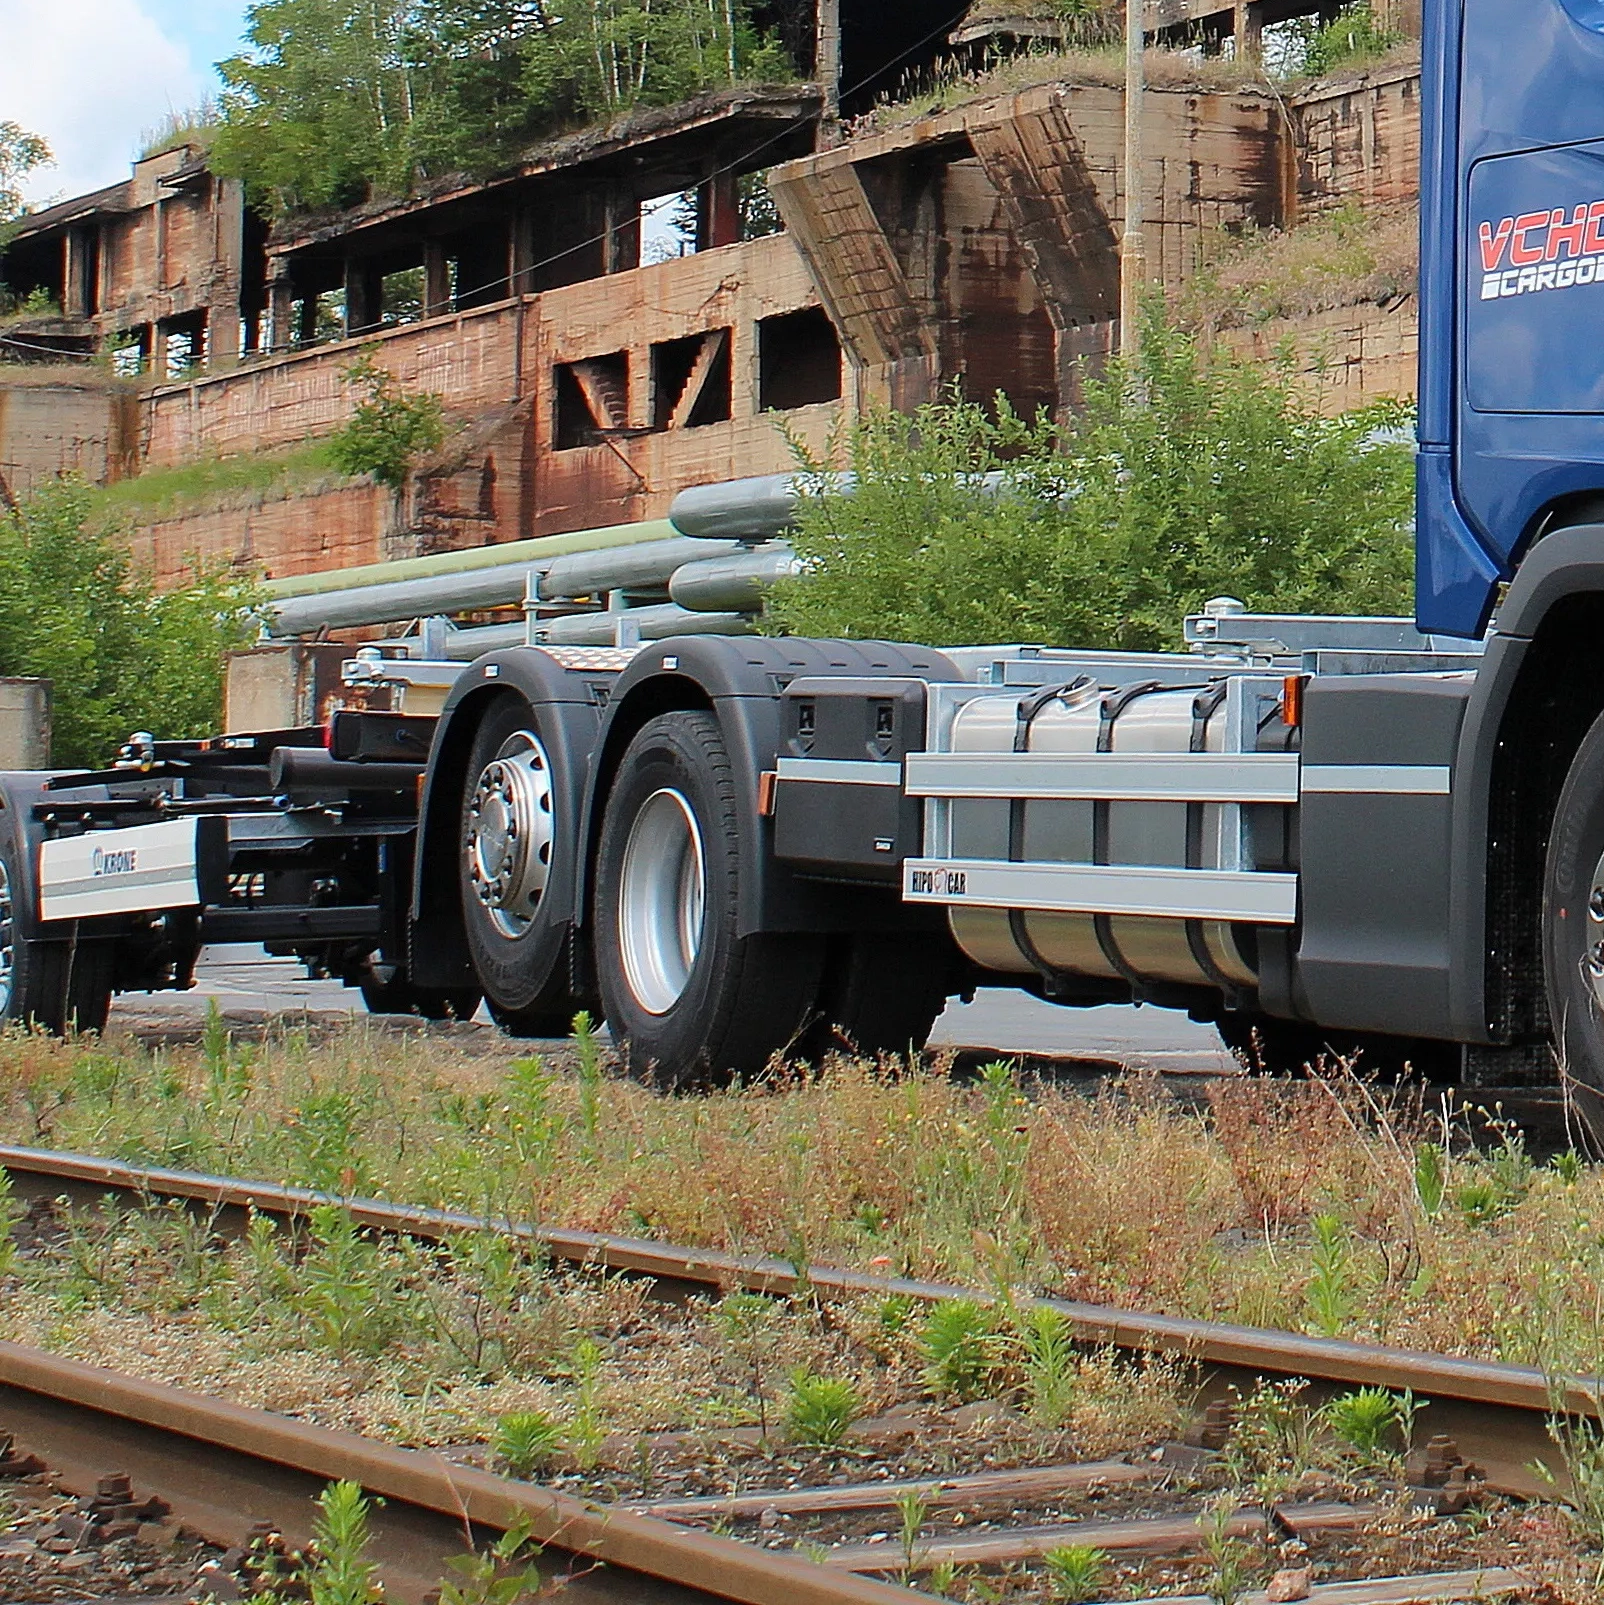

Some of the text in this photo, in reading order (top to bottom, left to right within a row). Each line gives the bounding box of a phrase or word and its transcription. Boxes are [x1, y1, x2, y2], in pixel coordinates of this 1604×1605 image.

[1500, 256, 1597, 297] CARGO
[912, 870, 966, 895] HIPO CAR
